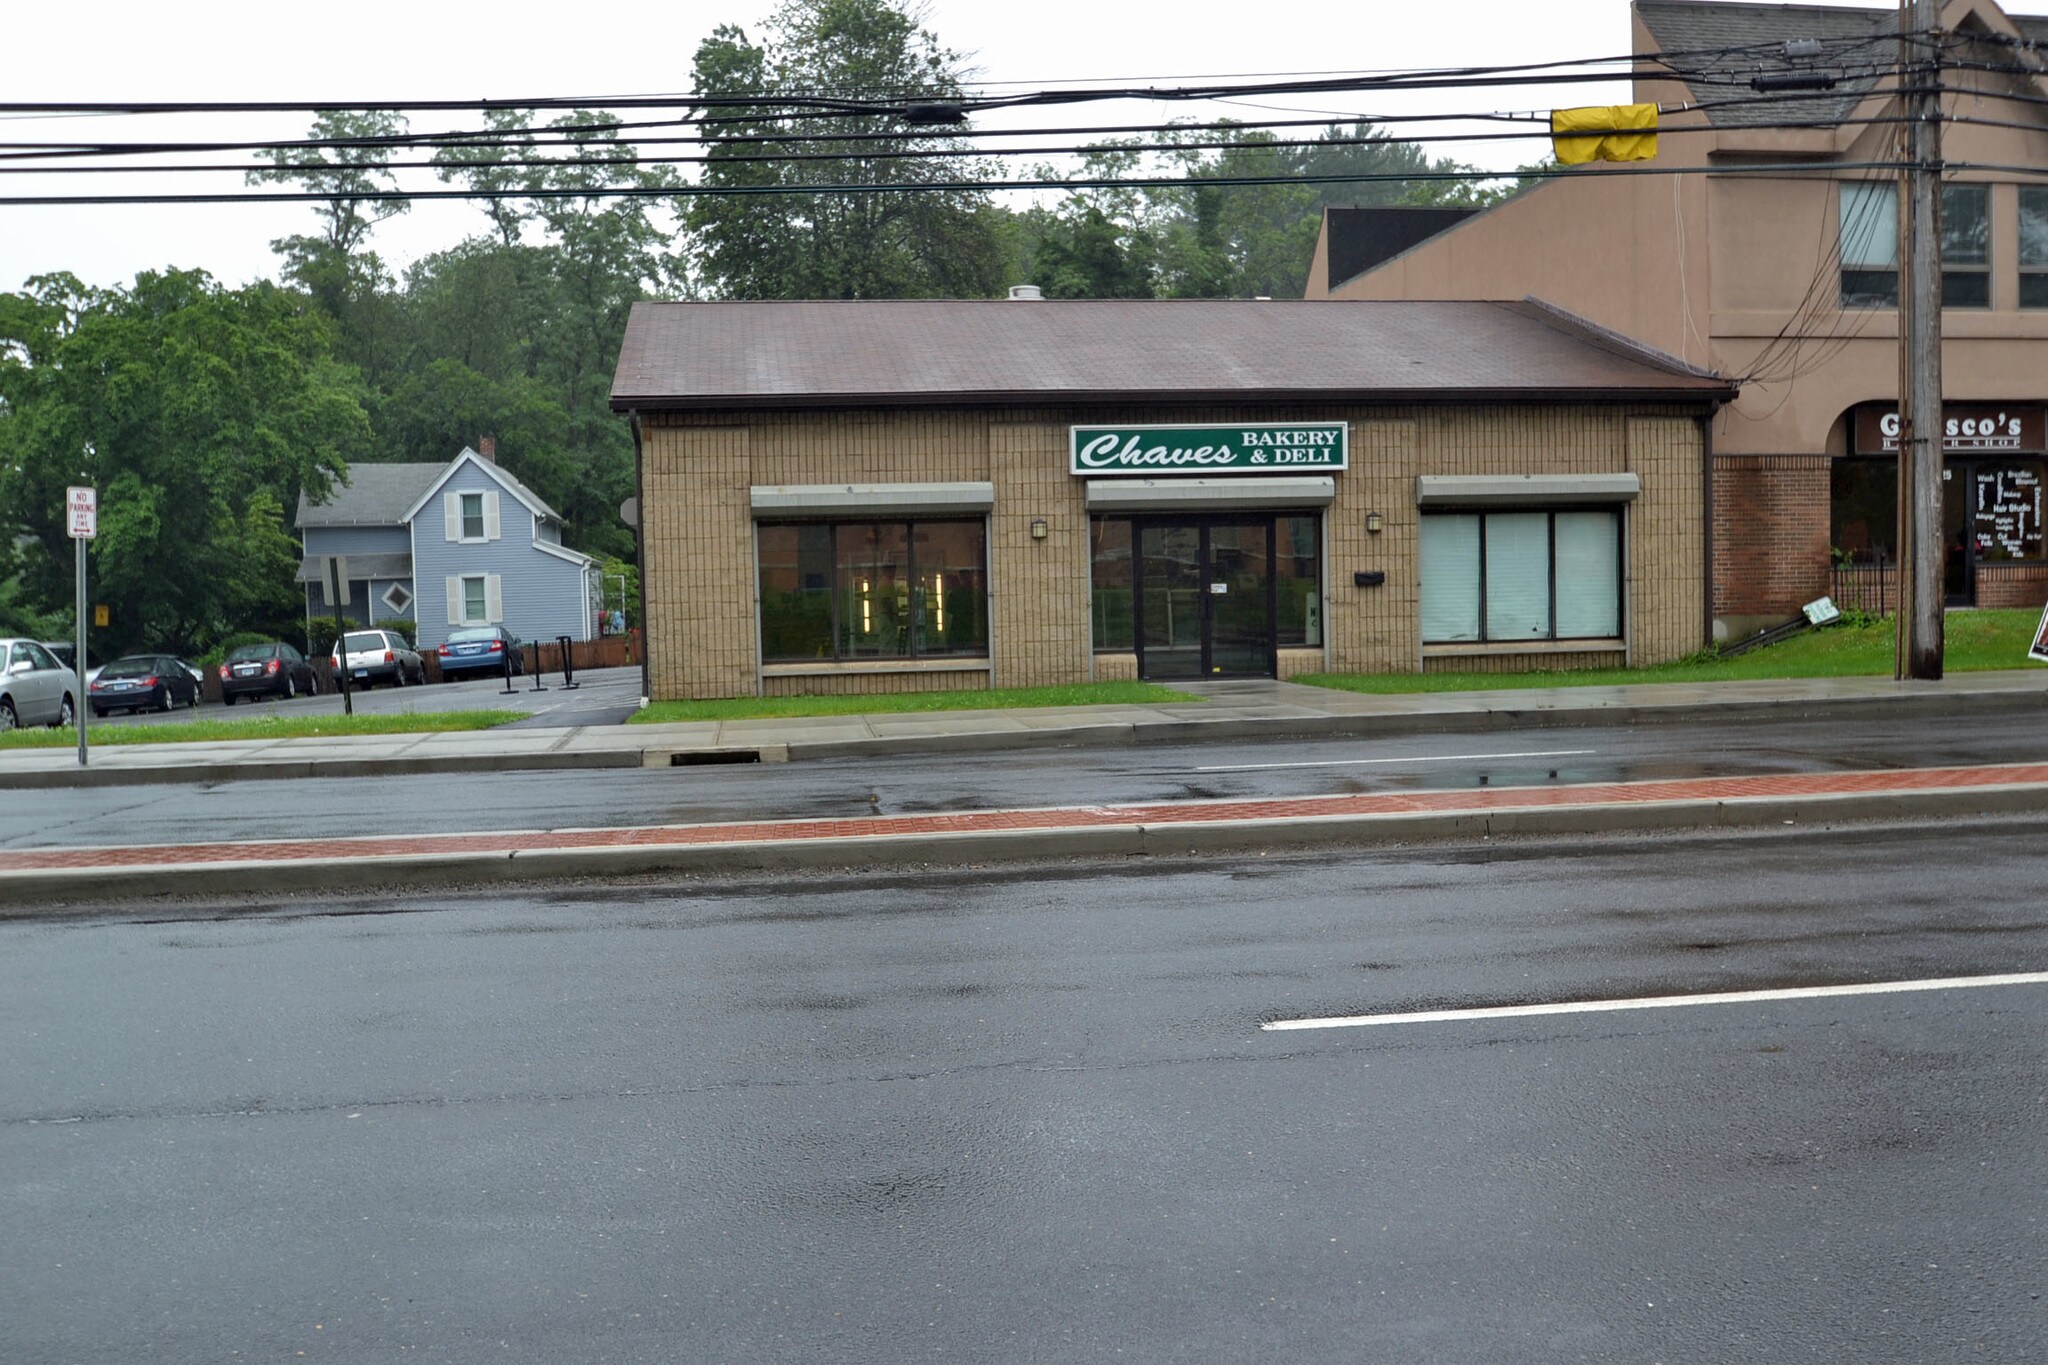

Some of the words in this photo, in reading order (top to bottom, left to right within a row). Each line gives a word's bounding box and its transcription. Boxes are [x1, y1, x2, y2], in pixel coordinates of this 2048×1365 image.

[1241, 430, 1339, 447] BAKERY
[1973, 439, 2021, 448] SHOP
[1080, 434, 1238, 467] Chaves
[1250, 449, 1268, 463] &
[1273, 448, 1332, 463] DELI
[1977, 473, 1995, 482] Wash
[76, 492, 87, 502] NO
[69, 503, 95, 513] PARKING
[1993, 503, 2007, 512] Hair
[2009, 503, 2032, 512] Studio
